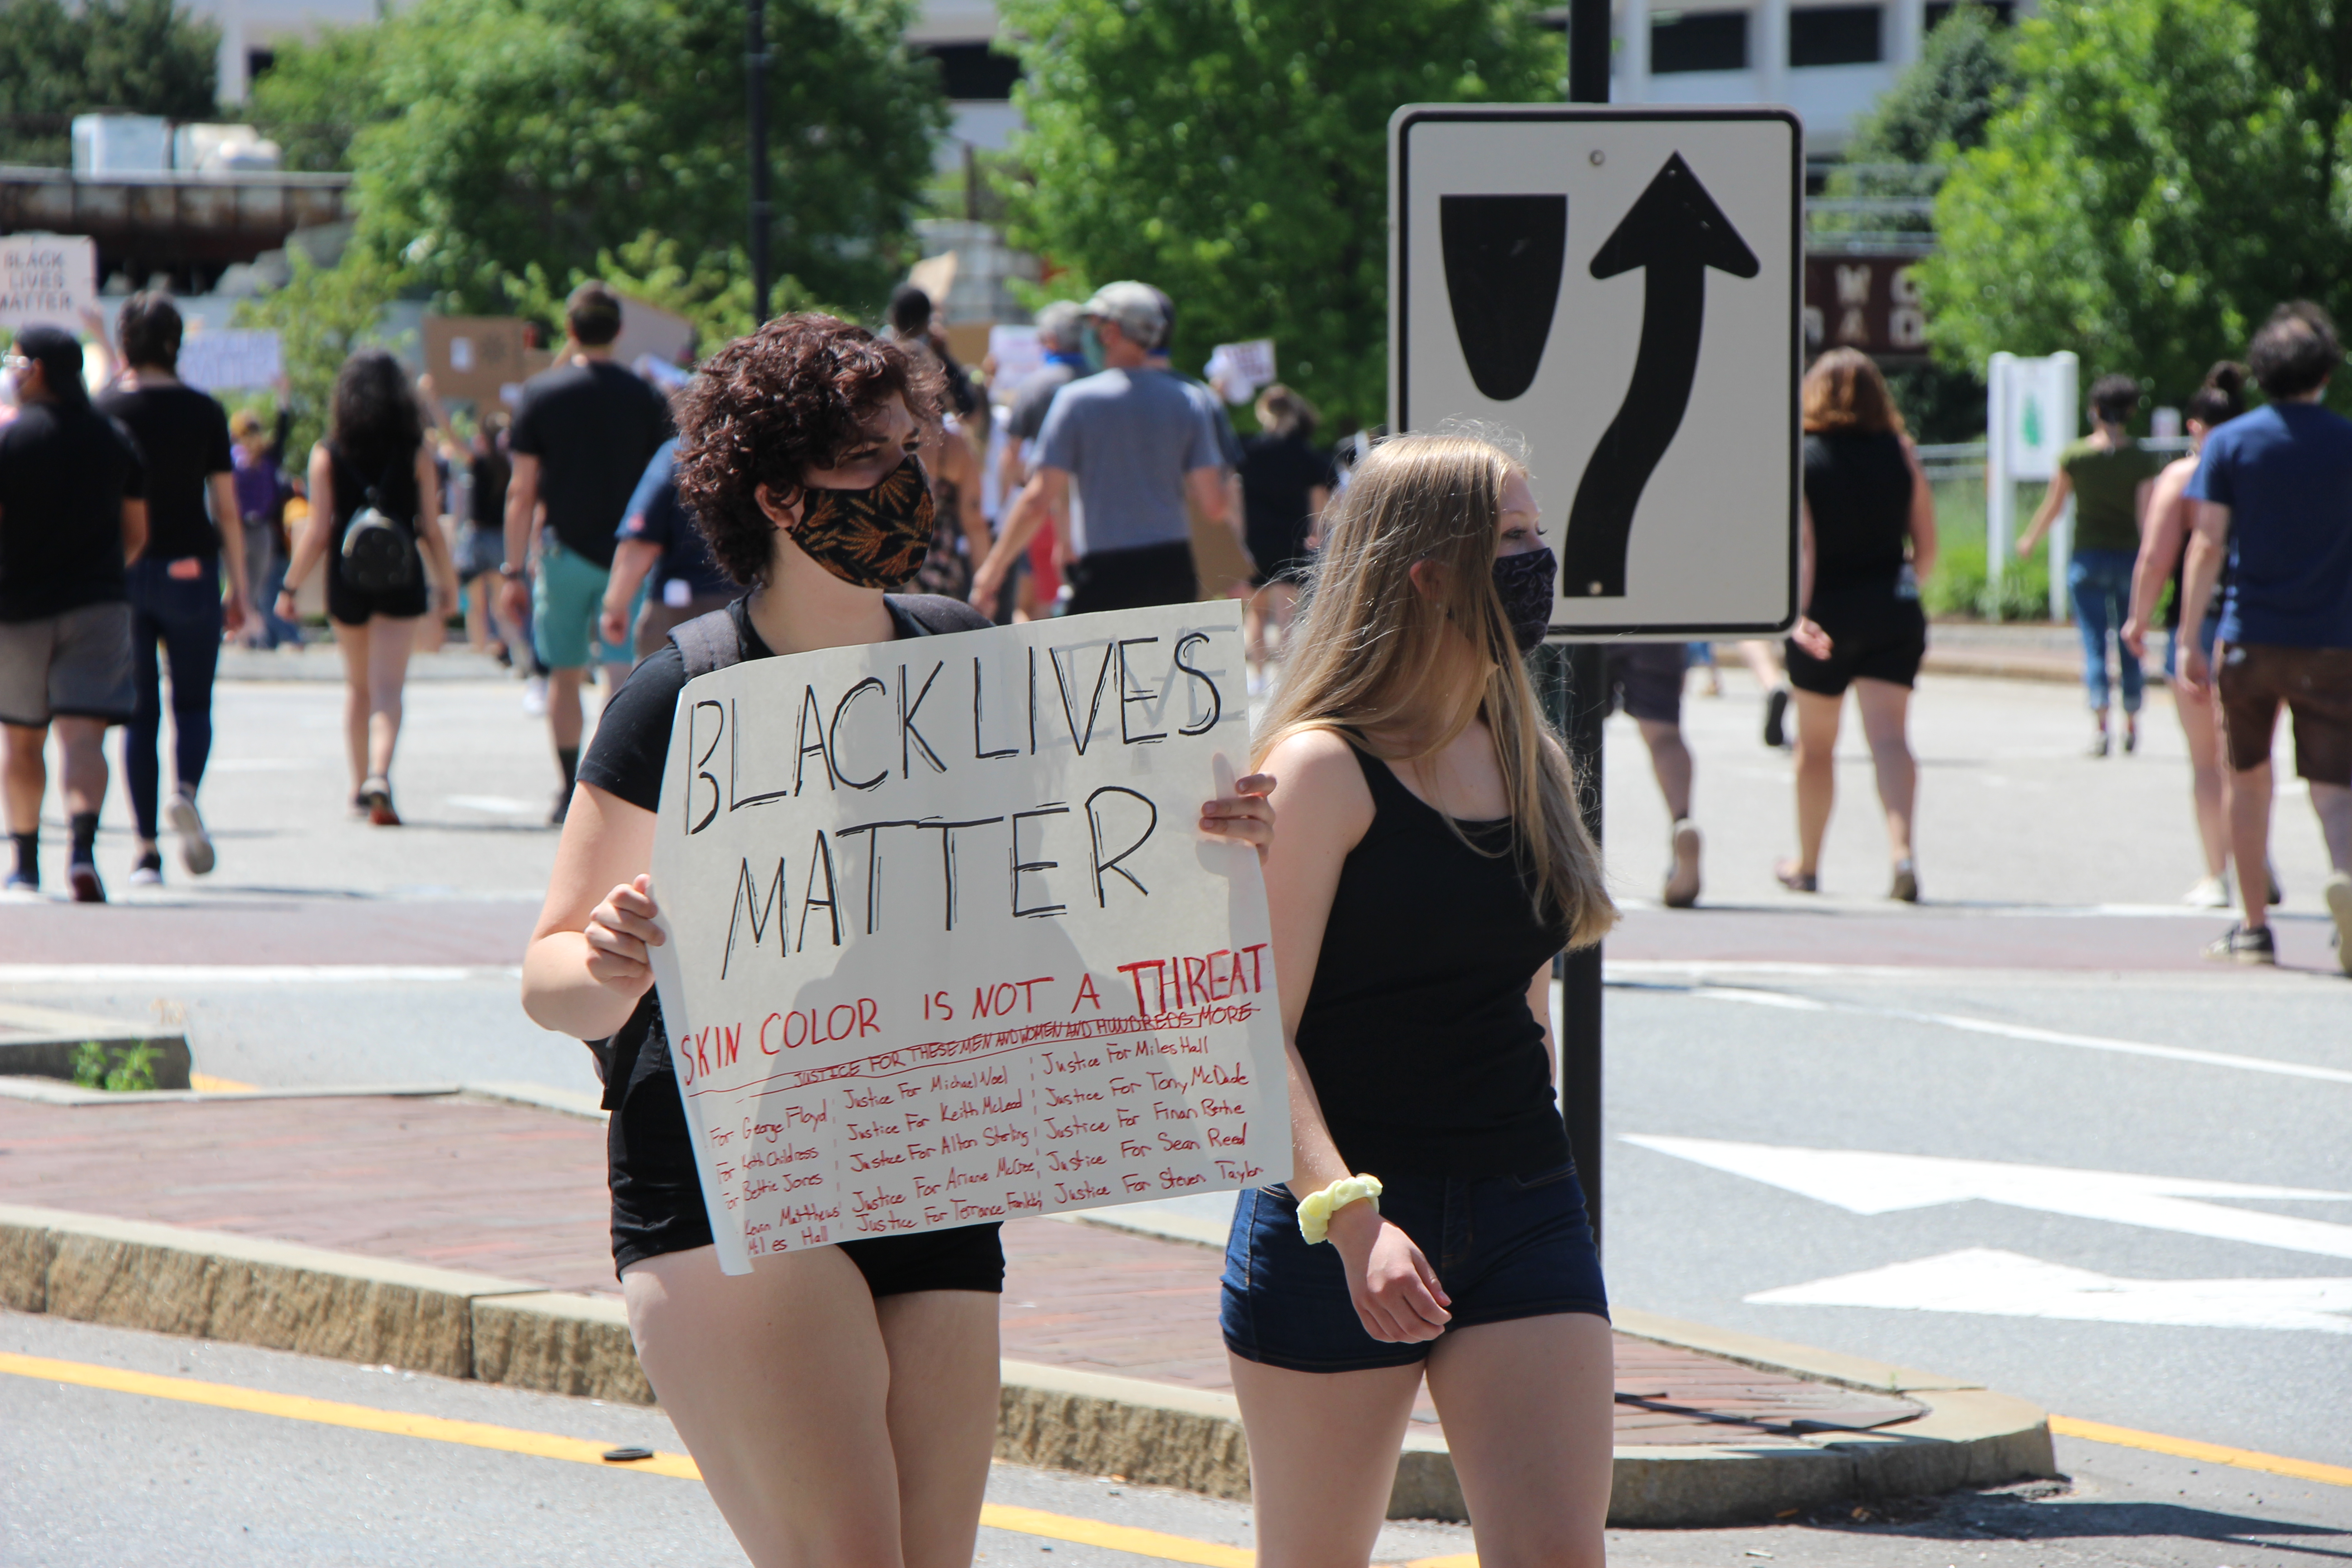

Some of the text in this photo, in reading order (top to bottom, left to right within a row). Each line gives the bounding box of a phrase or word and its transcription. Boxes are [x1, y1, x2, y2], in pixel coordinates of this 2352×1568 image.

[685, 632, 1222, 836] BLACK LIVES
[722, 785, 1157, 980] MATTER
[681, 943, 1268, 1086] SKIN COLOR IS NOT A THREAT
[794, 1063, 861, 1087] JUSTICE
[868, 1051, 906, 1072] FOR
[1201, 1001, 1253, 1026] MORE
[1041, 1035, 1209, 1075] Justice For Miles Hall
[843, 1065, 1008, 1109] Justice For Michael Noel
[1045, 1061, 1250, 1107] Justice For Tony McDade
[742, 1117, 784, 1143] George
[785, 1098, 828, 1133] Floyd
[847, 1121, 901, 1141] Justice
[904, 1113, 931, 1132] For
[939, 1101, 980, 1122] Keith
[1043, 1114, 1110, 1139] Justice
[1116, 1108, 1140, 1128] For
[849, 1150, 906, 1172] Justice
[906, 1143, 936, 1161] For
[941, 1133, 979, 1156] Alton
[1046, 1149, 1107, 1171] Justice
[1120, 1139, 1152, 1158] For
[1158, 1132, 1200, 1152] Sean
[782, 1173, 824, 1192] Jones
[852, 1186, 907, 1213] Justice
[913, 1176, 941, 1199] For
[1054, 1160, 1264, 1204] Justice For Steven Taylor
[801, 1225, 829, 1245] Hall
[855, 1210, 918, 1232] Justice
[923, 1206, 949, 1226] For
[950, 1198, 1007, 1221] Terrance
